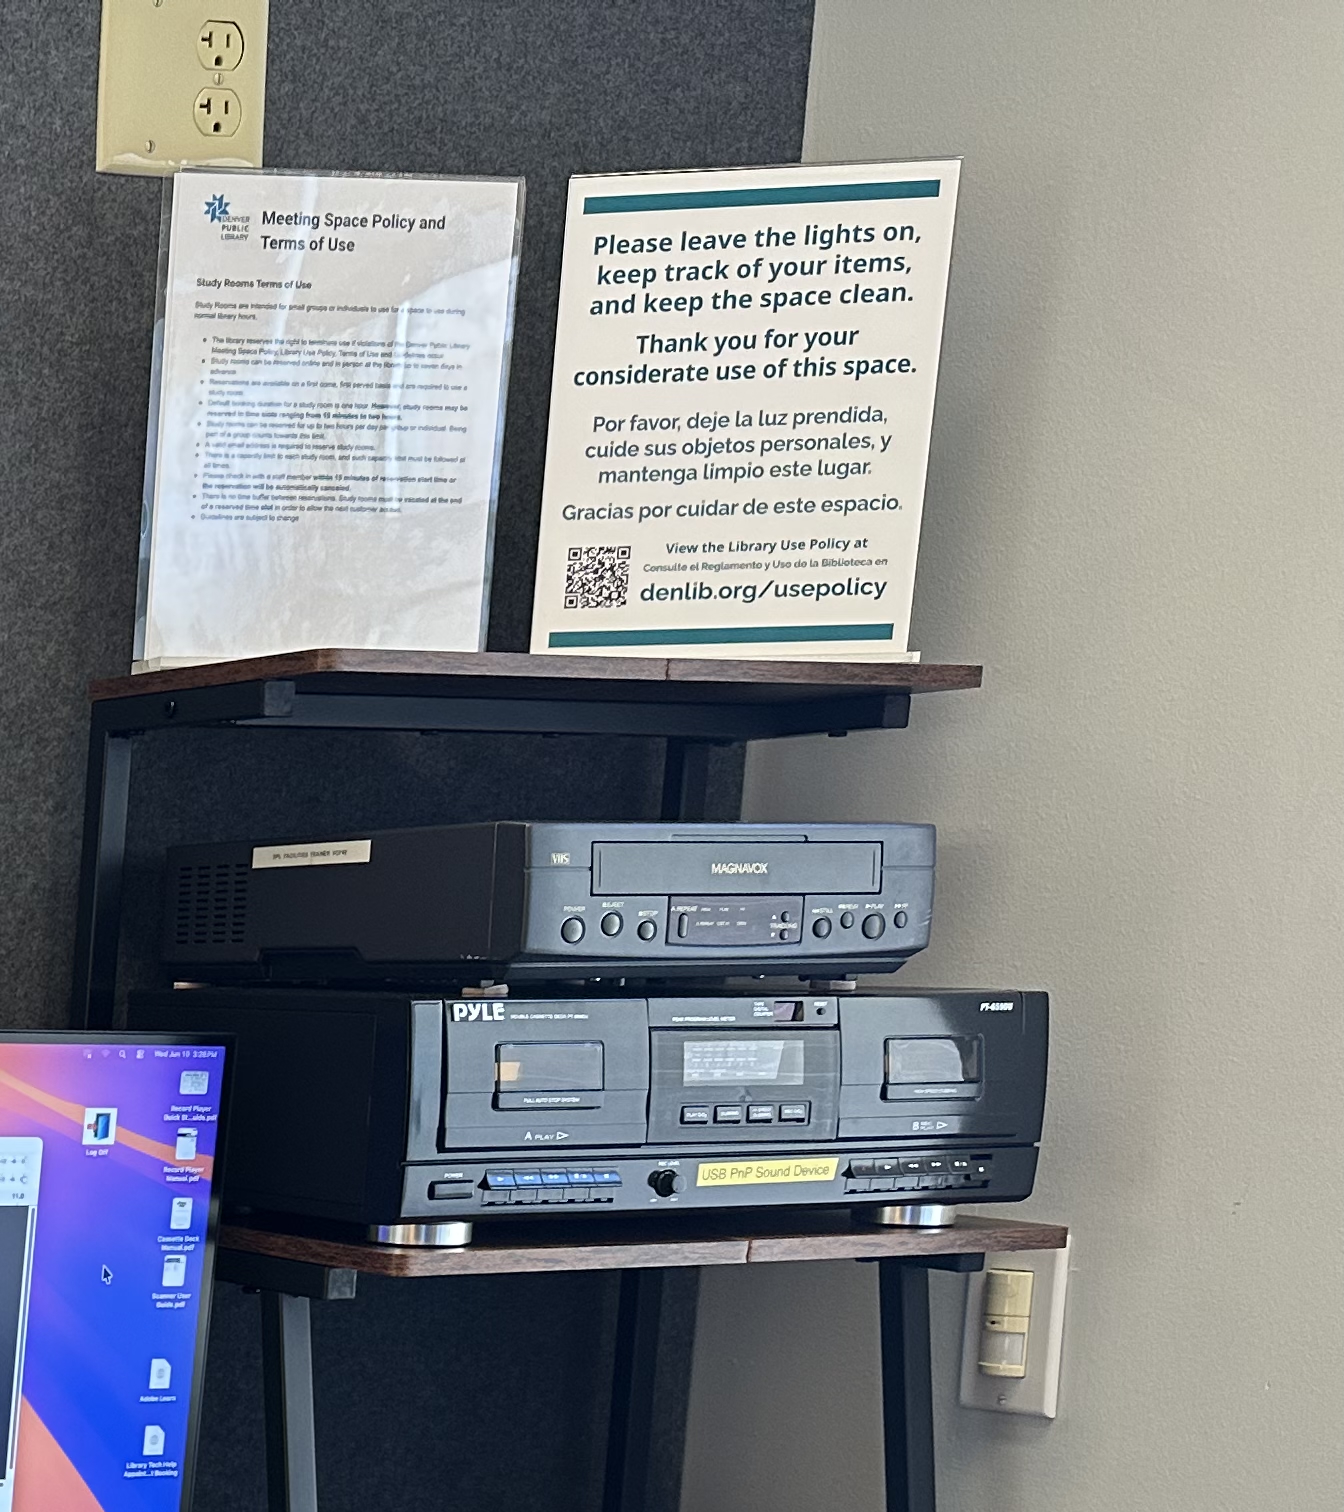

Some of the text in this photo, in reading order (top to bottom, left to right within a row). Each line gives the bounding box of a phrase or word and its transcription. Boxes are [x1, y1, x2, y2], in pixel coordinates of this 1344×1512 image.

[262, 211, 446, 233] Meeting Space Policy and
[260, 235, 355, 252] Terms of Use
[594, 223, 921, 255] Please leave the lights on,
[196, 278, 312, 289] Study Rooms Terms of Use
[598, 254, 911, 289] keep track of your items,
[590, 283, 913, 317] and keep the space clean.
[636, 329, 859, 357] Thank you for your
[574, 356, 916, 386] considerate use of this space.
[593, 406, 887, 432] Por favor, deje la luz prendida,
[585, 432, 892, 458] cuide sus objetos personales, y
[598, 459, 871, 485] mantenga limpio este lugar.
[562, 494, 902, 523] Gracias por cuidar de este espacio.
[666, 538, 868, 554] View the Library Use Policy at
[690, 562, 699, 571] el
[701, 561, 762, 572] Reglamento
[764, 562, 770, 571] y
[772, 560, 792, 569] Uso
[810, 559, 819, 567] la
[640, 577, 887, 603] denlib.org/usepolicy
[552, 853, 569, 864] VHS
[711, 862, 769, 874] MAGNAVOX
[453, 1002, 505, 1022] PYLE
[524, 1131, 533, 1141] A
[702, 1163, 830, 1180] USB PnP Sound Device
